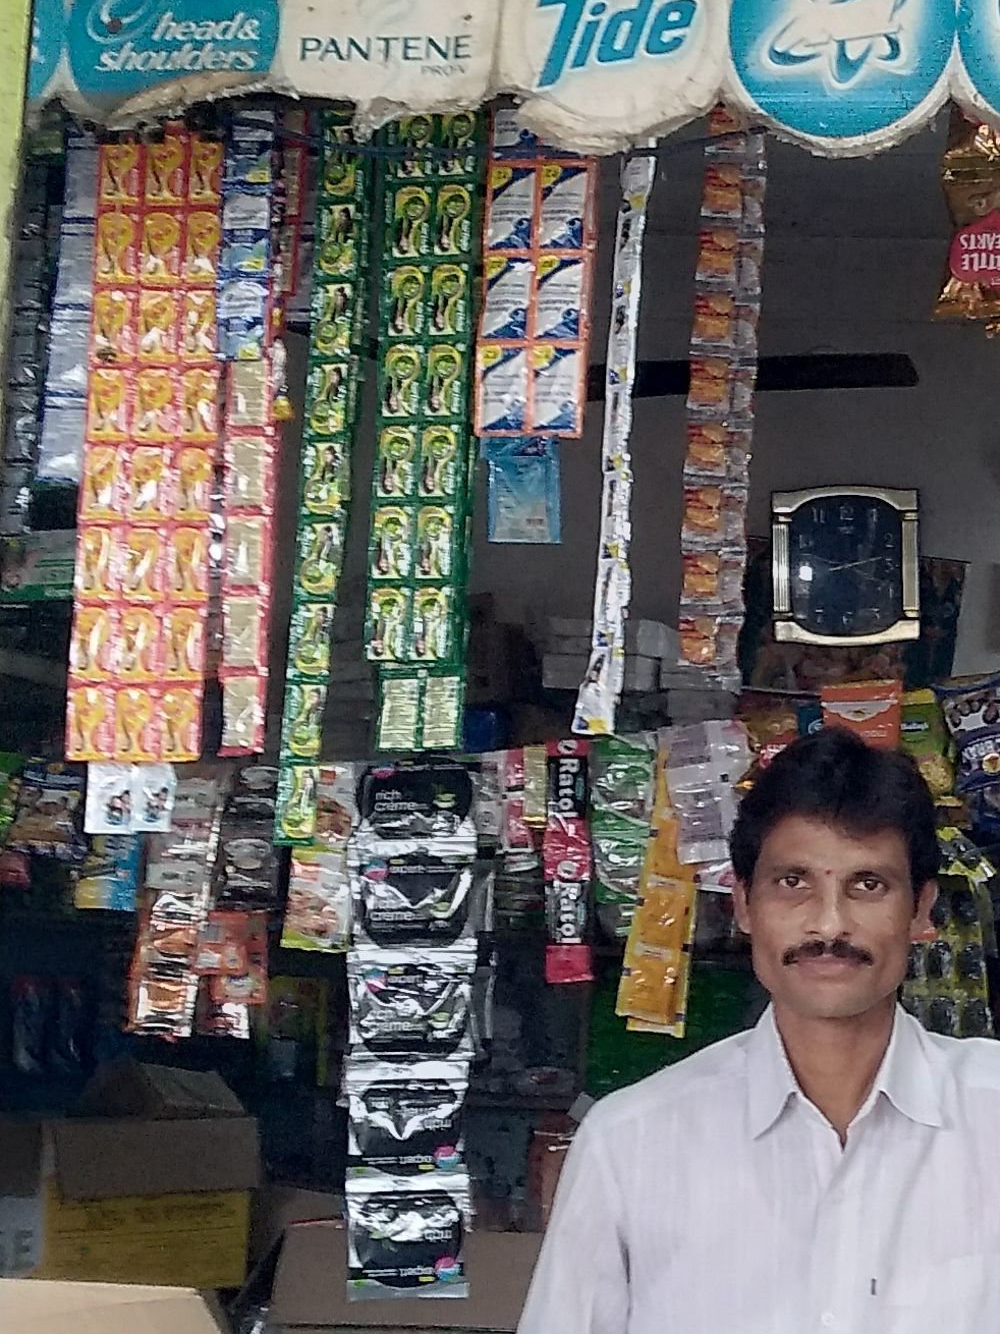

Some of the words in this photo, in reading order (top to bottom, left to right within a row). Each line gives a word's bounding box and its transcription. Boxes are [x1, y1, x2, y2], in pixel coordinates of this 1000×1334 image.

[95, 41, 257, 73] shoulders
[301, 34, 471, 63] PANTENE
[559, 757, 581, 818] Ratol
